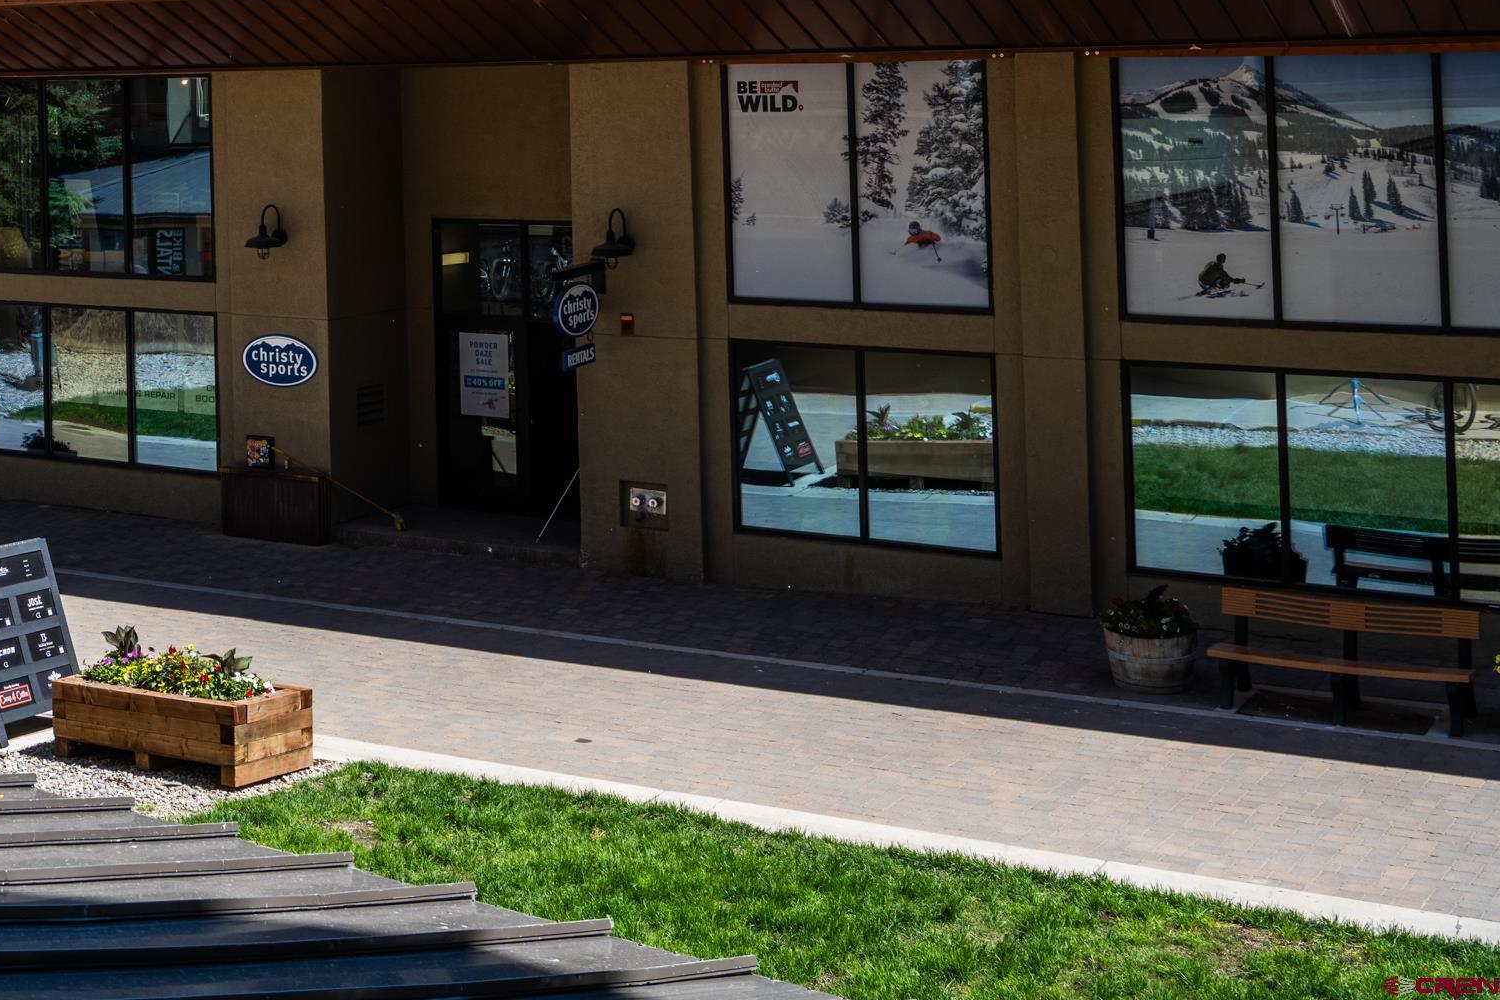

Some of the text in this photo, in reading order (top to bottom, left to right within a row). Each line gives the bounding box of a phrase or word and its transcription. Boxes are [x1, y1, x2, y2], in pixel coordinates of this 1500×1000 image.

[737, 81, 758, 94] BE
[563, 297, 592, 315] christy
[568, 309, 595, 328] sports
[469, 340, 498, 349] POWDER
[251, 347, 303, 368] christy
[475, 350, 492, 358] DAZE
[567, 347, 595, 368] RENTALS
[260, 362, 308, 377] sports
[144, 390, 176, 400] REPAIR
[195, 395, 216, 403] BOO
